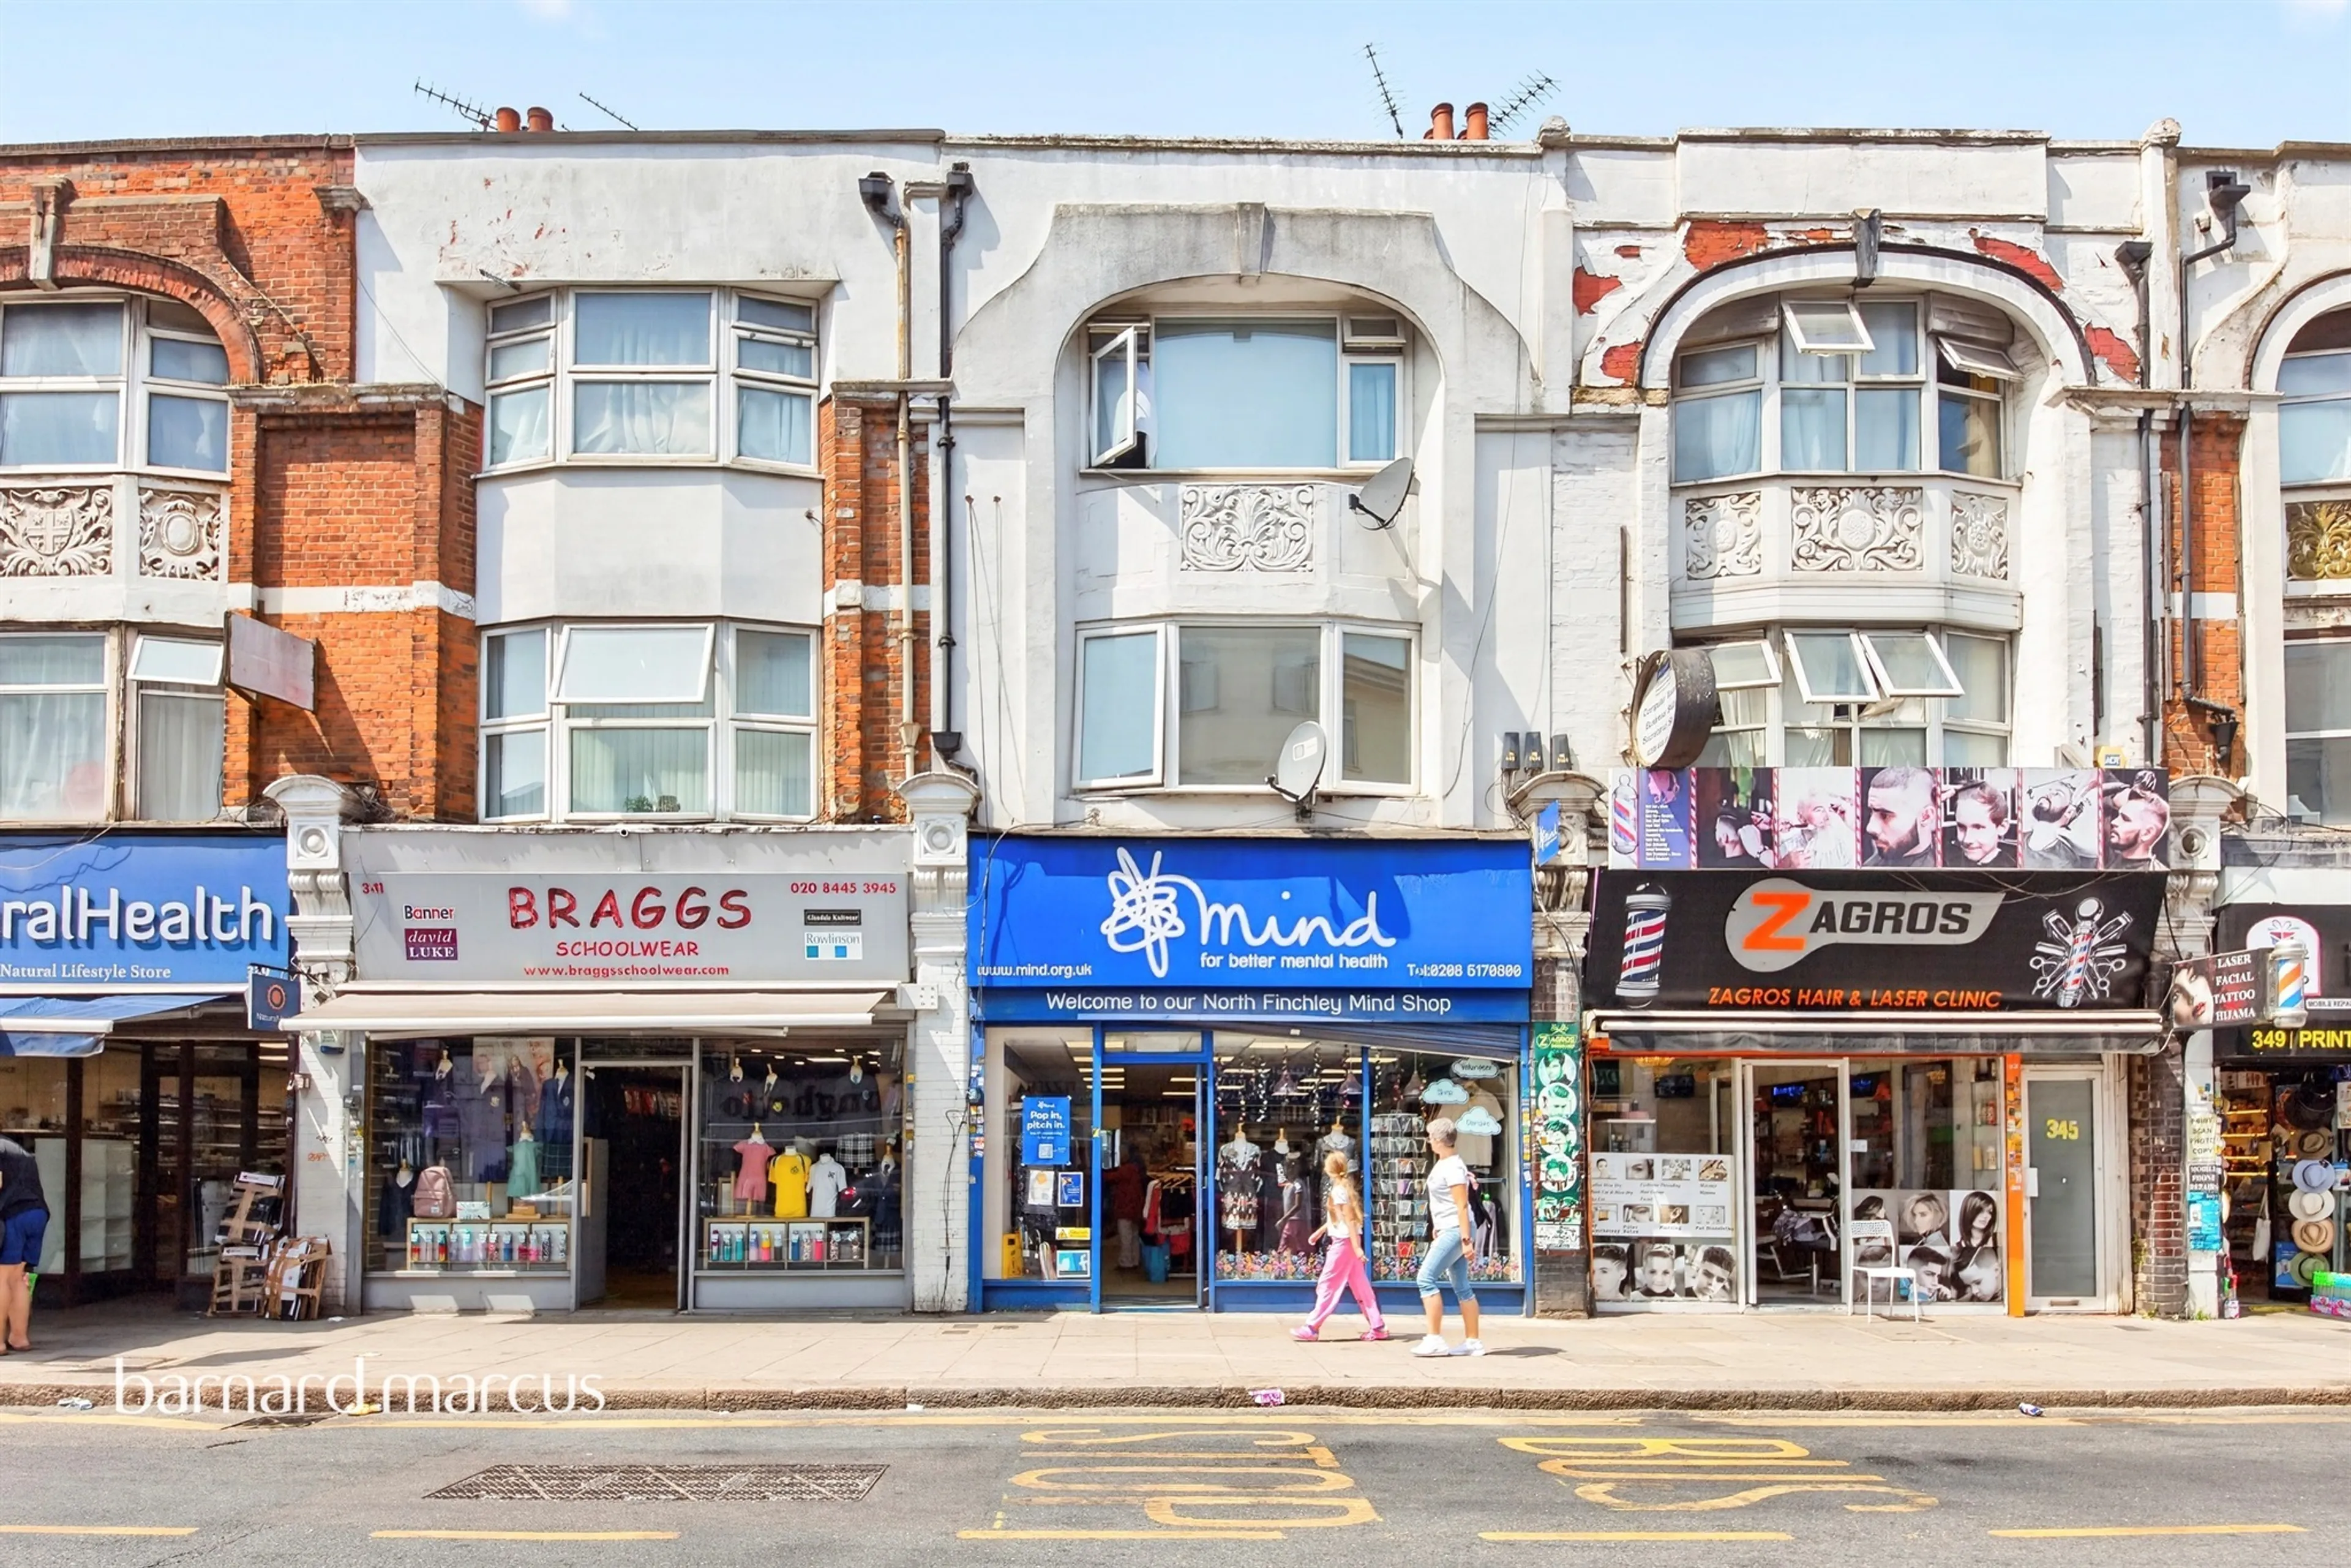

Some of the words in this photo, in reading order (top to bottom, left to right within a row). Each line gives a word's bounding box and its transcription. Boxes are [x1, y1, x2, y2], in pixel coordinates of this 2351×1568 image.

[790, 882, 817, 894] 020
[823, 882, 857, 894] 8445
[863, 882, 896, 894] 3945
[404, 905, 454, 919] Banner
[508, 886, 752, 929] BRAGGS
[1199, 891, 1397, 947] mind
[1742, 893, 1972, 951] ZAGROS
[408, 931, 452, 942] david
[806, 933, 860, 944] Rowlinson
[409, 947, 454, 957] LUKE
[556, 940, 699, 957] SCHOOLWEAR
[1200, 952, 1223, 968] for
[1229, 953, 1276, 969] better
[1281, 953, 1333, 969] mental
[1339, 953, 1389, 969] health
[2218, 953, 2252, 969] LASER
[1, 964, 56, 978] Natural
[61, 964, 127, 981] Lifestyle
[130, 966, 171, 978] Store
[523, 964, 729, 978] www.braggsschoolwear.com
[977, 963, 1092, 978] www.mind.org.uk
[2216, 971, 2254, 986] FACIAL
[1046, 992, 1133, 1010] Welcome
[1139, 994, 1157, 1010] to
[1164, 997, 1196, 1010] our
[1204, 993, 1256, 1010] North
[1263, 994, 1342, 1015] Finchley
[1349, 994, 1395, 1011] Mind
[1402, 994, 1452, 1015] Shop
[1708, 987, 1791, 1006] ZAGROS
[1798, 988, 1843, 1007] HAIR
[1849, 989, 1861, 1007] &
[1871, 989, 1928, 1007] LASER
[1933, 989, 2003, 1008] CLINIC
[2213, 989, 2255, 1004] TATTOO
[2216, 1007, 2255, 1021] HIJAMA
[2252, 1030, 2286, 1048] 349
[1030, 1111, 1049, 1120] Pop
[1027, 1121, 1052, 1131] pitch
[2047, 1119, 2079, 1139] 345
[1003, 1430, 1382, 1528] STOP
